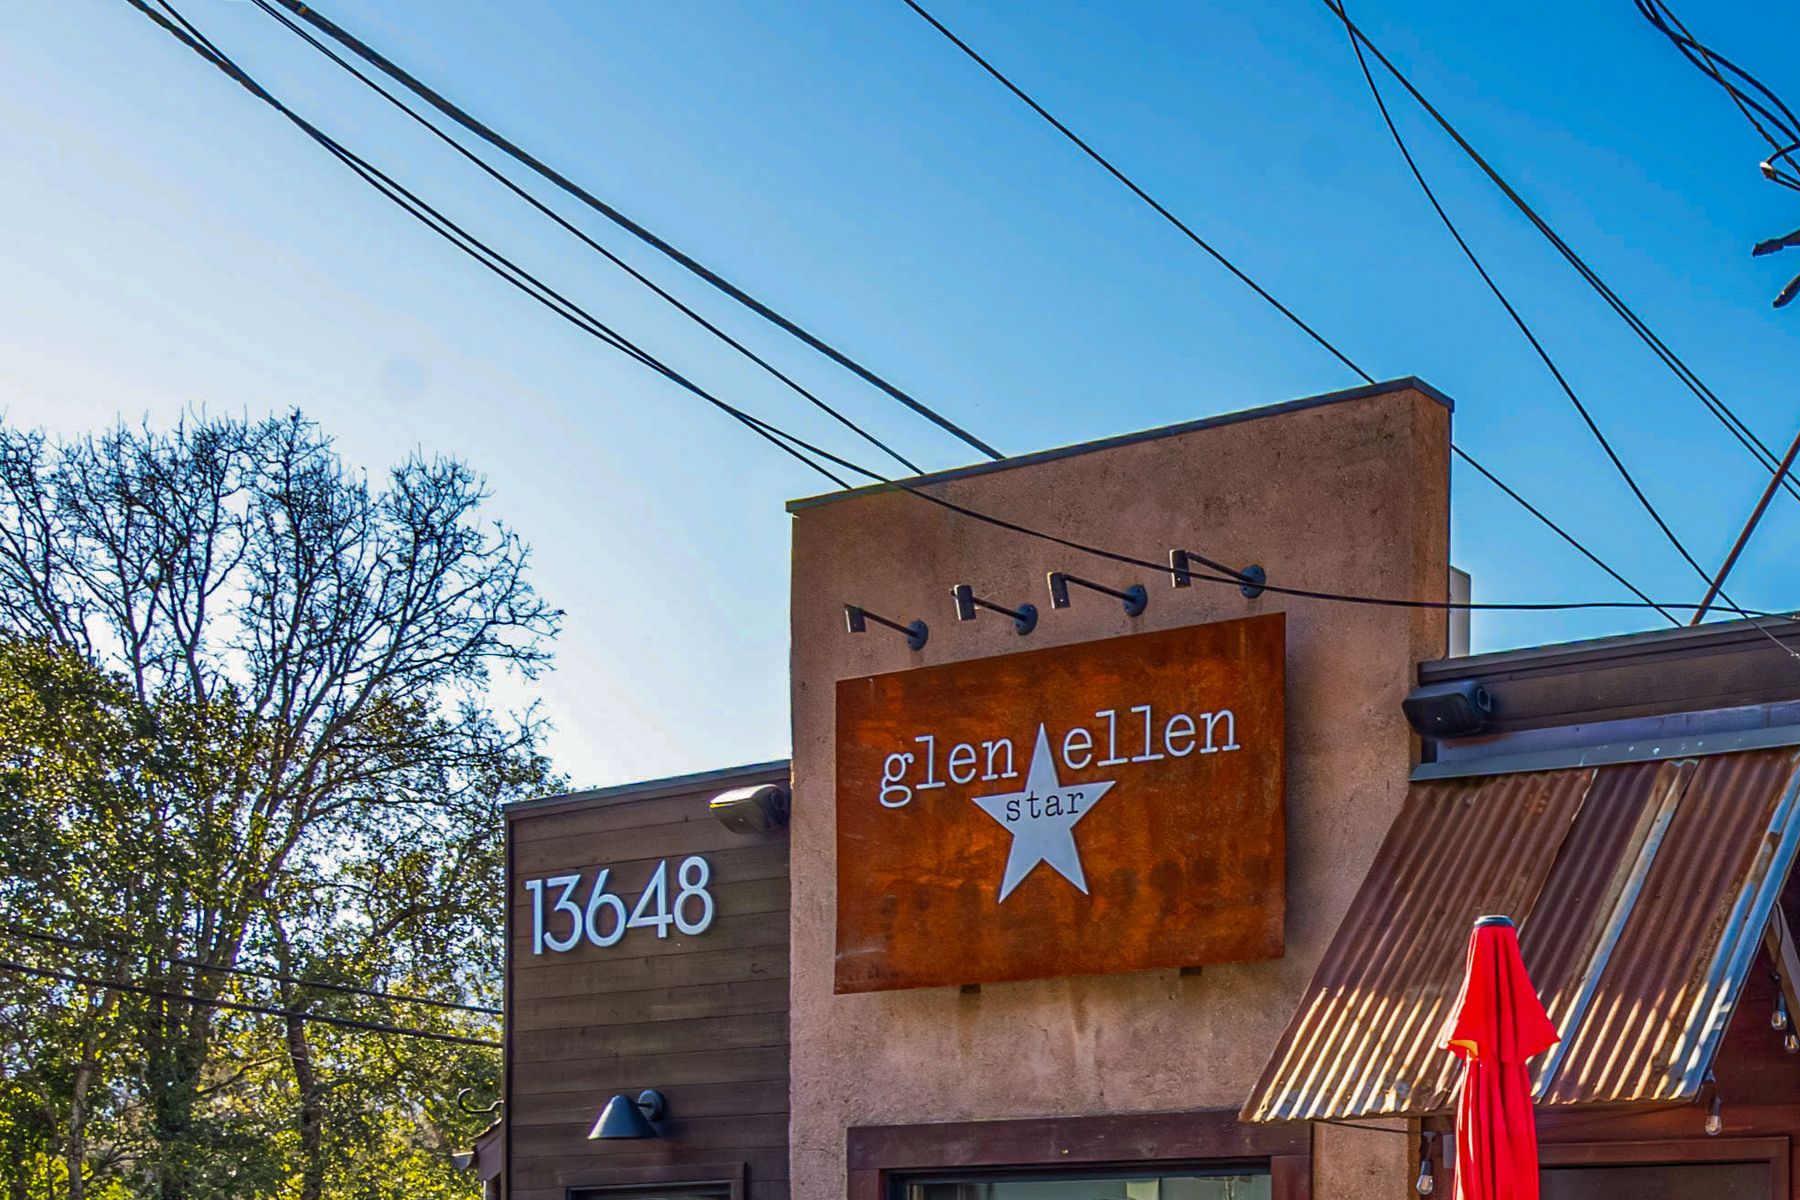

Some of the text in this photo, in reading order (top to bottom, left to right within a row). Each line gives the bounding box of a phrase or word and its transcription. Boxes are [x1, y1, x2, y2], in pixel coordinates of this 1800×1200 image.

[879, 704, 1241, 808] glen ellen
[1006, 790, 1085, 822] star
[525, 856, 714, 955] 13648
